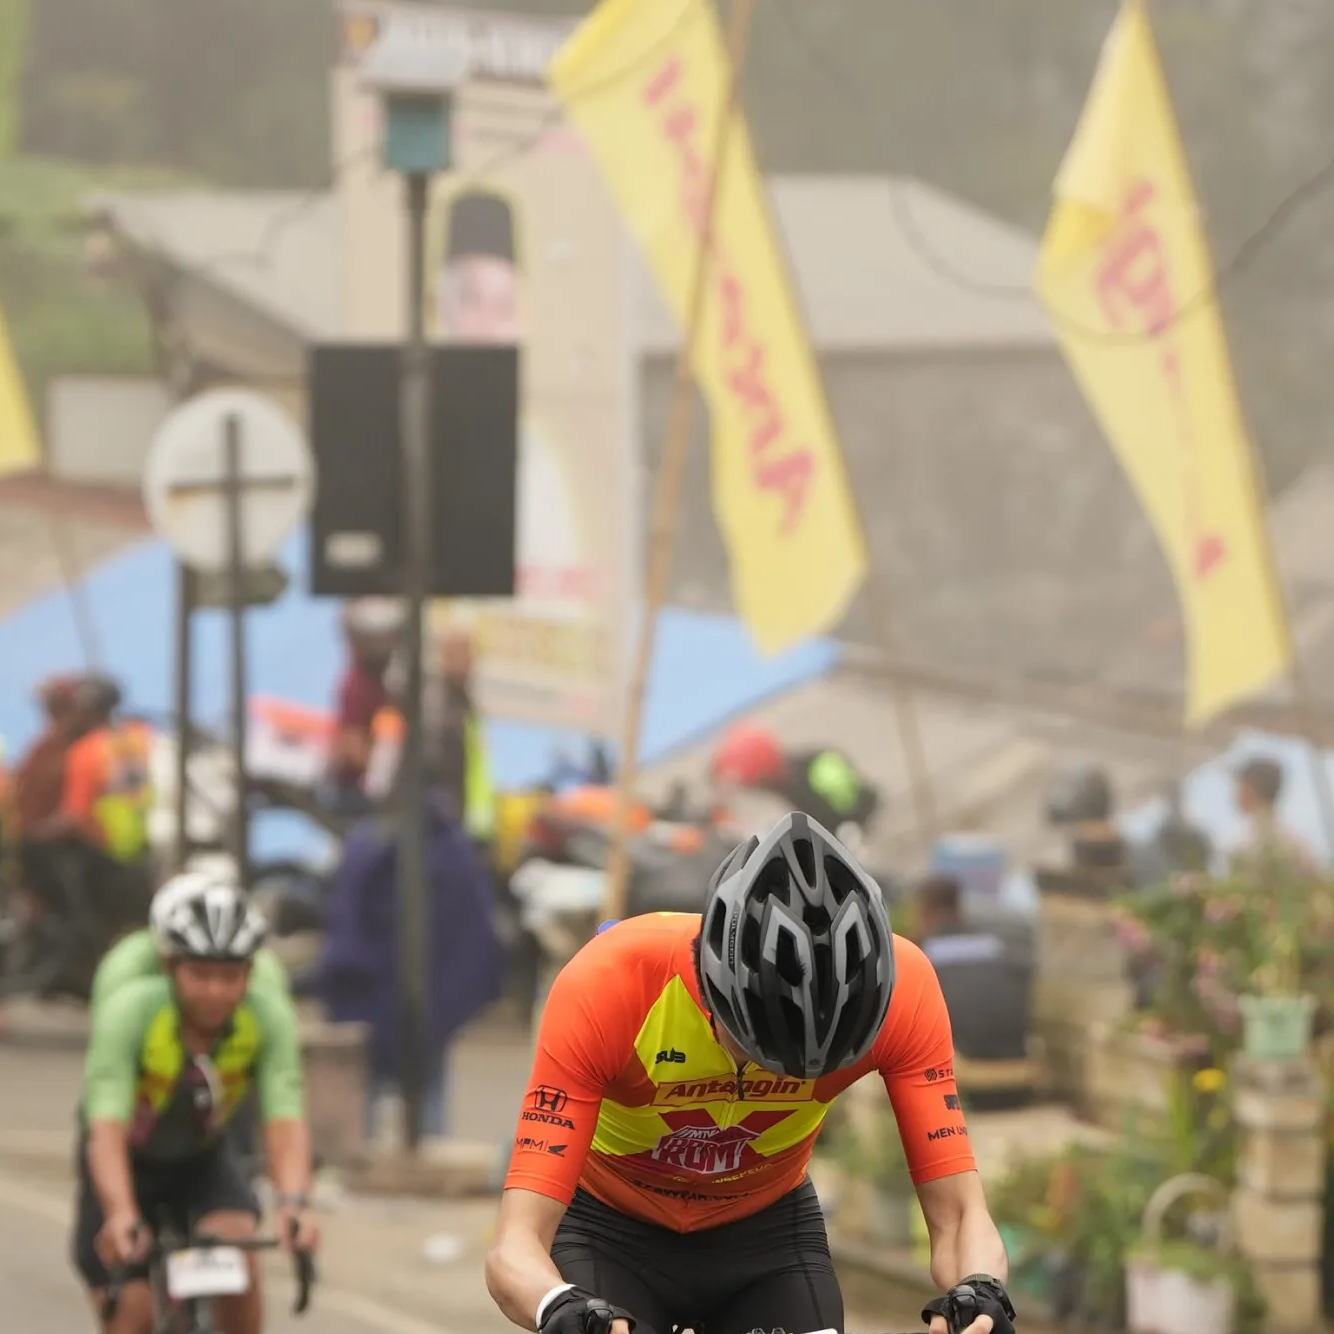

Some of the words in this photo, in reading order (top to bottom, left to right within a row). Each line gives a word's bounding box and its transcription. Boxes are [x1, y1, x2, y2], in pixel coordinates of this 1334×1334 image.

[728, 910, 740, 964] POLYGON
[522, 1112, 575, 1130] HONDA
[927, 1126, 955, 1141] MEN
